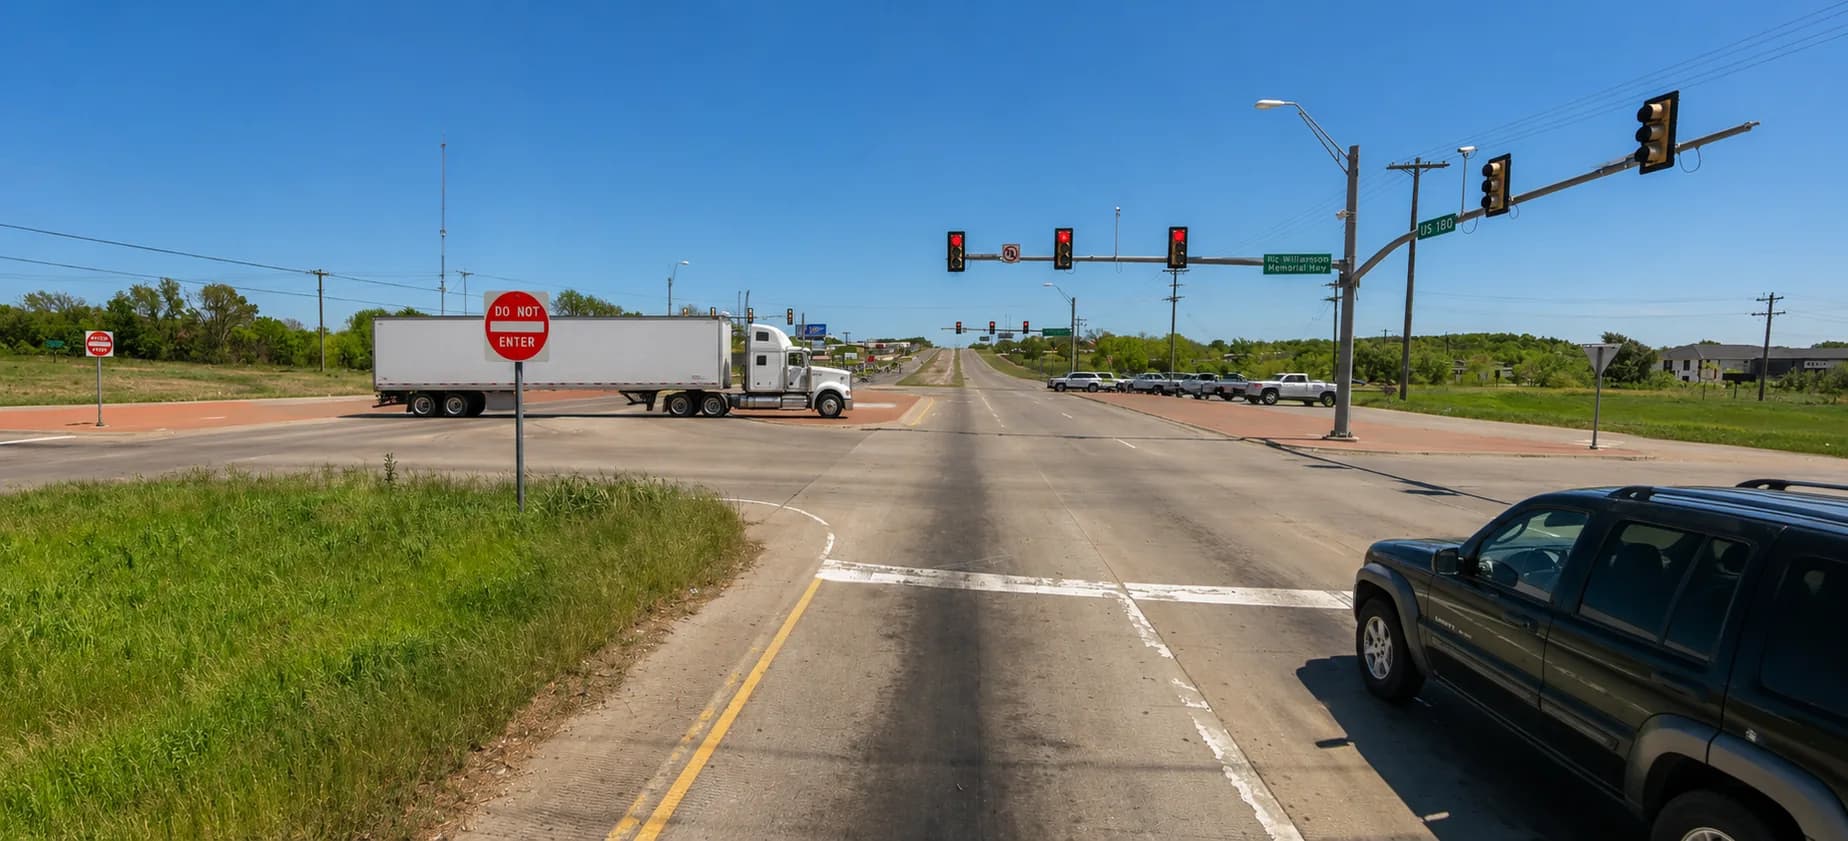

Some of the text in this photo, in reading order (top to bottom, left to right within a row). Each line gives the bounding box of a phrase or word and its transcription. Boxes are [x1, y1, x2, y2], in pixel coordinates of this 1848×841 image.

[1420, 217, 1453, 236] US 180
[1268, 264, 1306, 272] Memorial
[495, 306, 540, 317] DO NOT
[499, 336, 535, 348] ENTER
